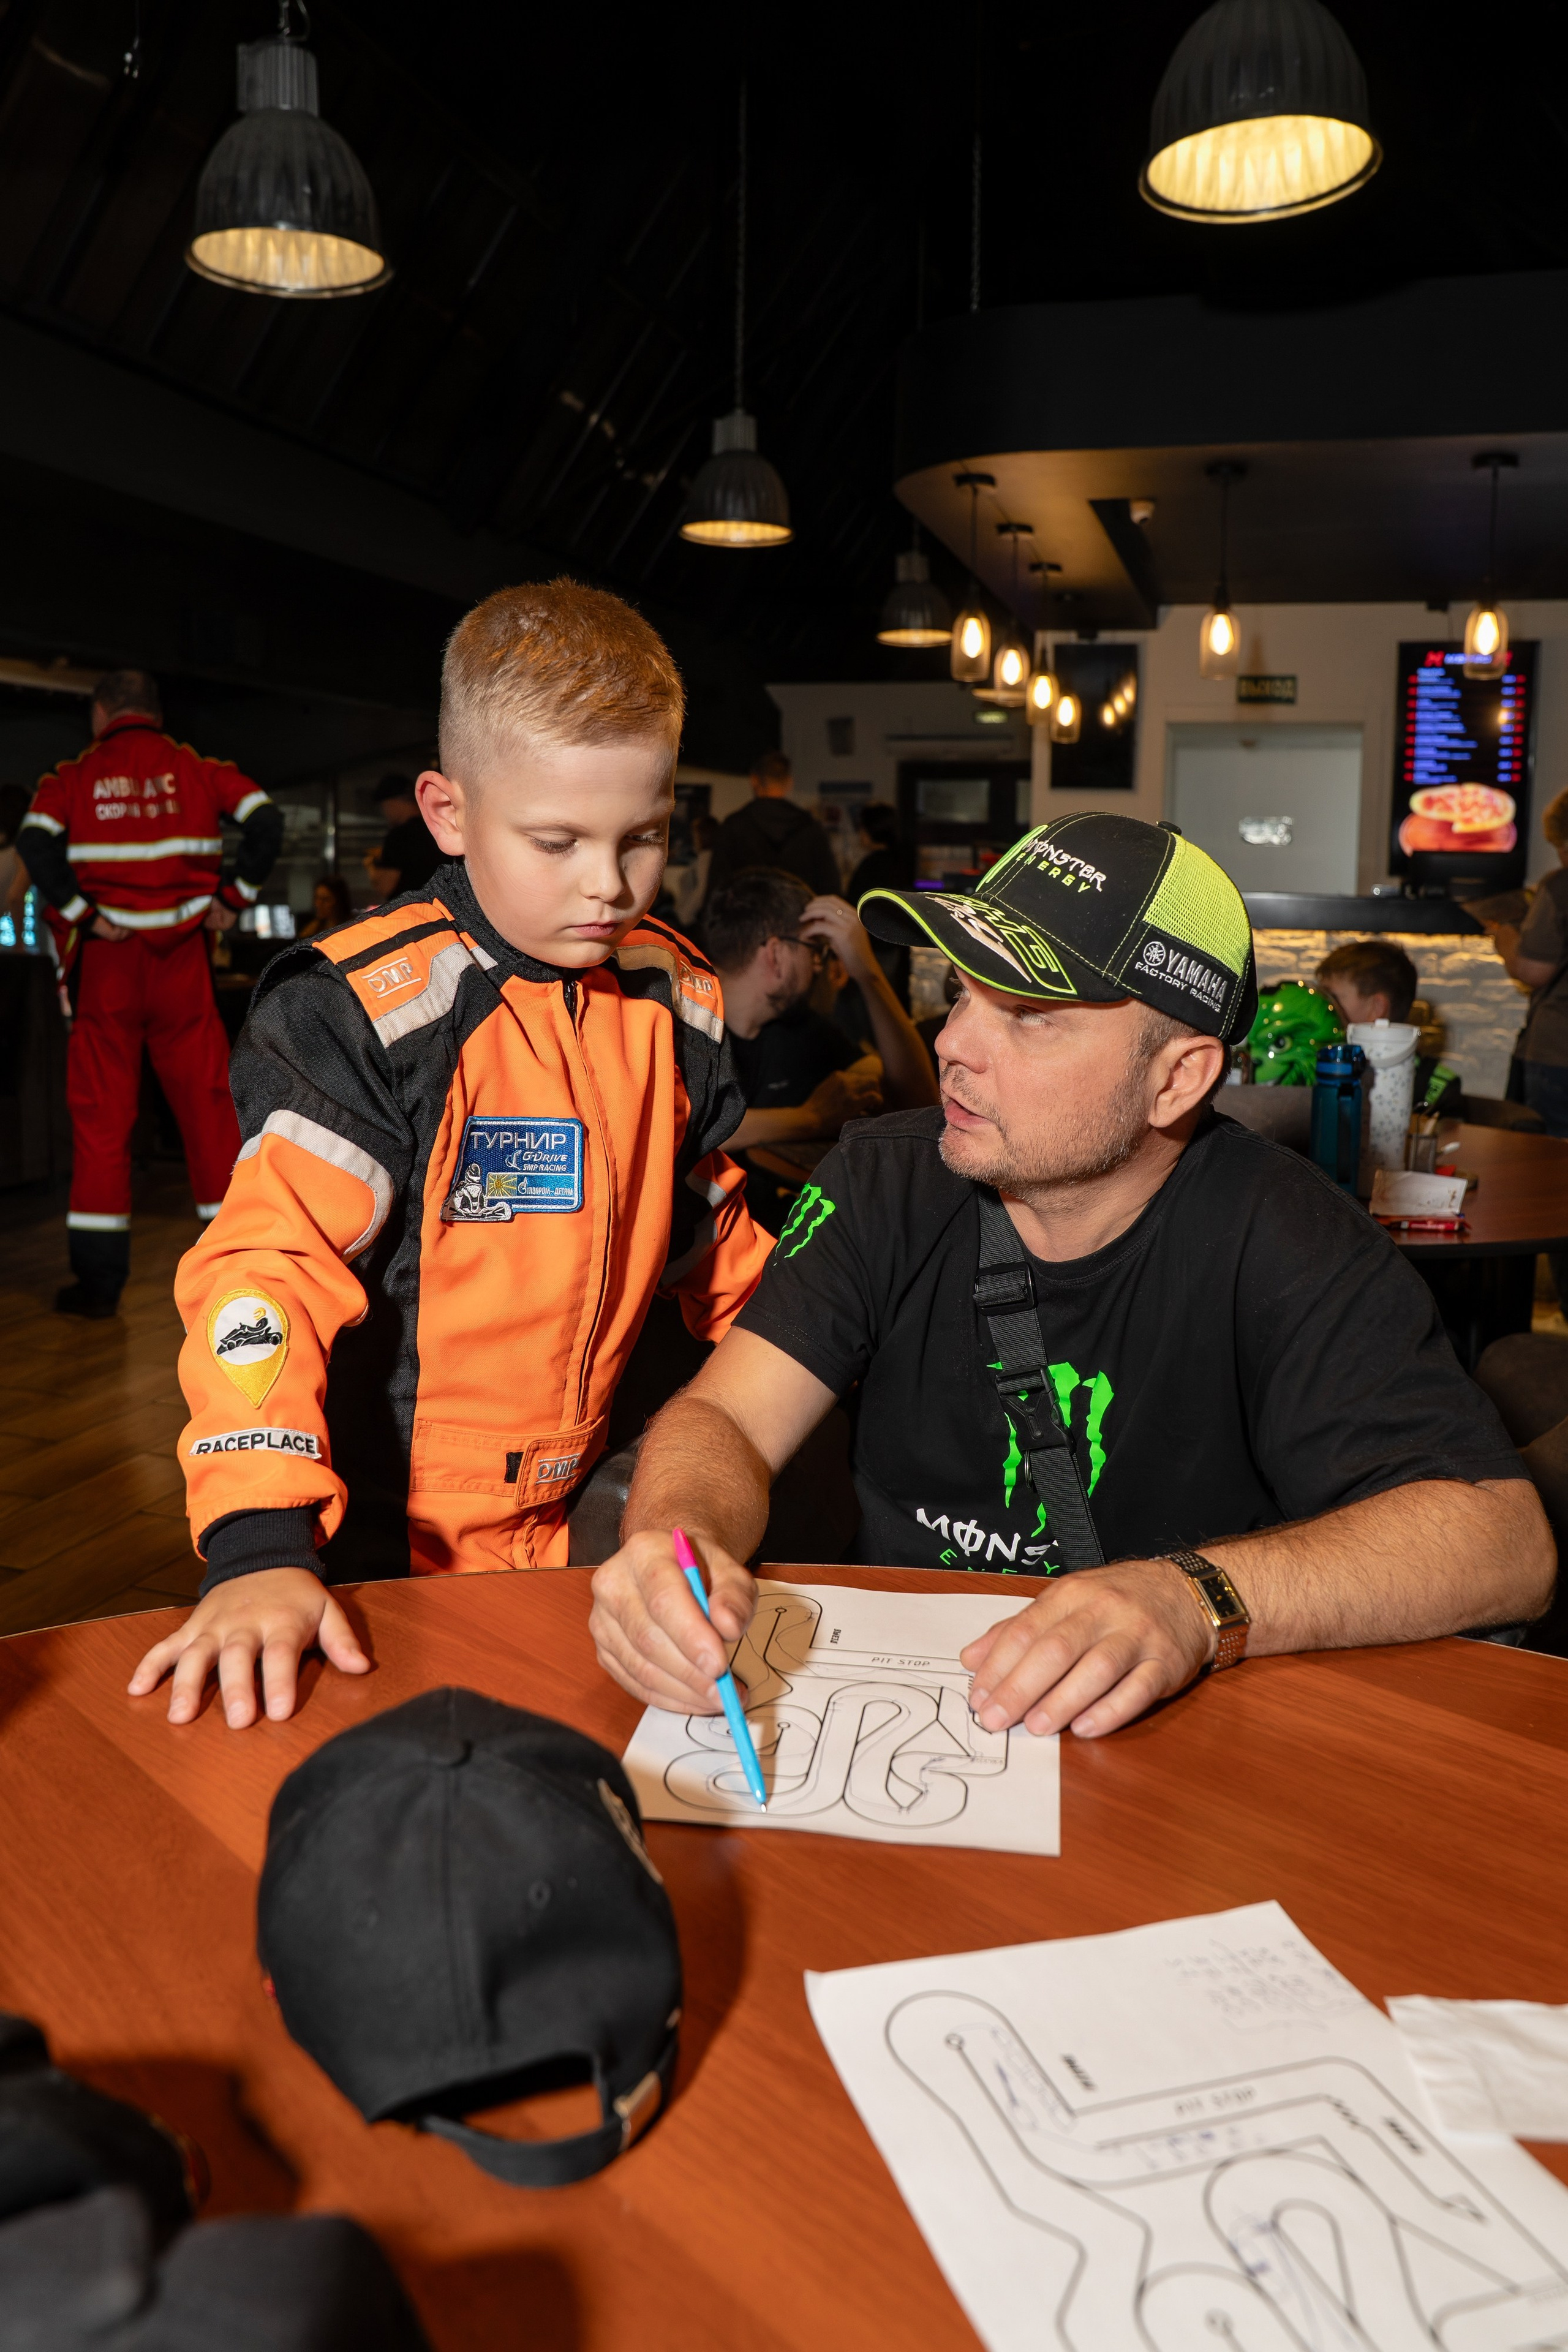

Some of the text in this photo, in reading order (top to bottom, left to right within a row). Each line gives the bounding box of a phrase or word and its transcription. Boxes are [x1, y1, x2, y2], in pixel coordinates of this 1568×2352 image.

[1016, 852, 1091, 893] ENERGY
[1134, 962, 1221, 1014] FACTORY RACING
[1166, 949, 1228, 1003] YAMAHA
[470, 1132, 566, 1150] ТУРНИР
[197, 1432, 316, 1455] RACEPLACE
